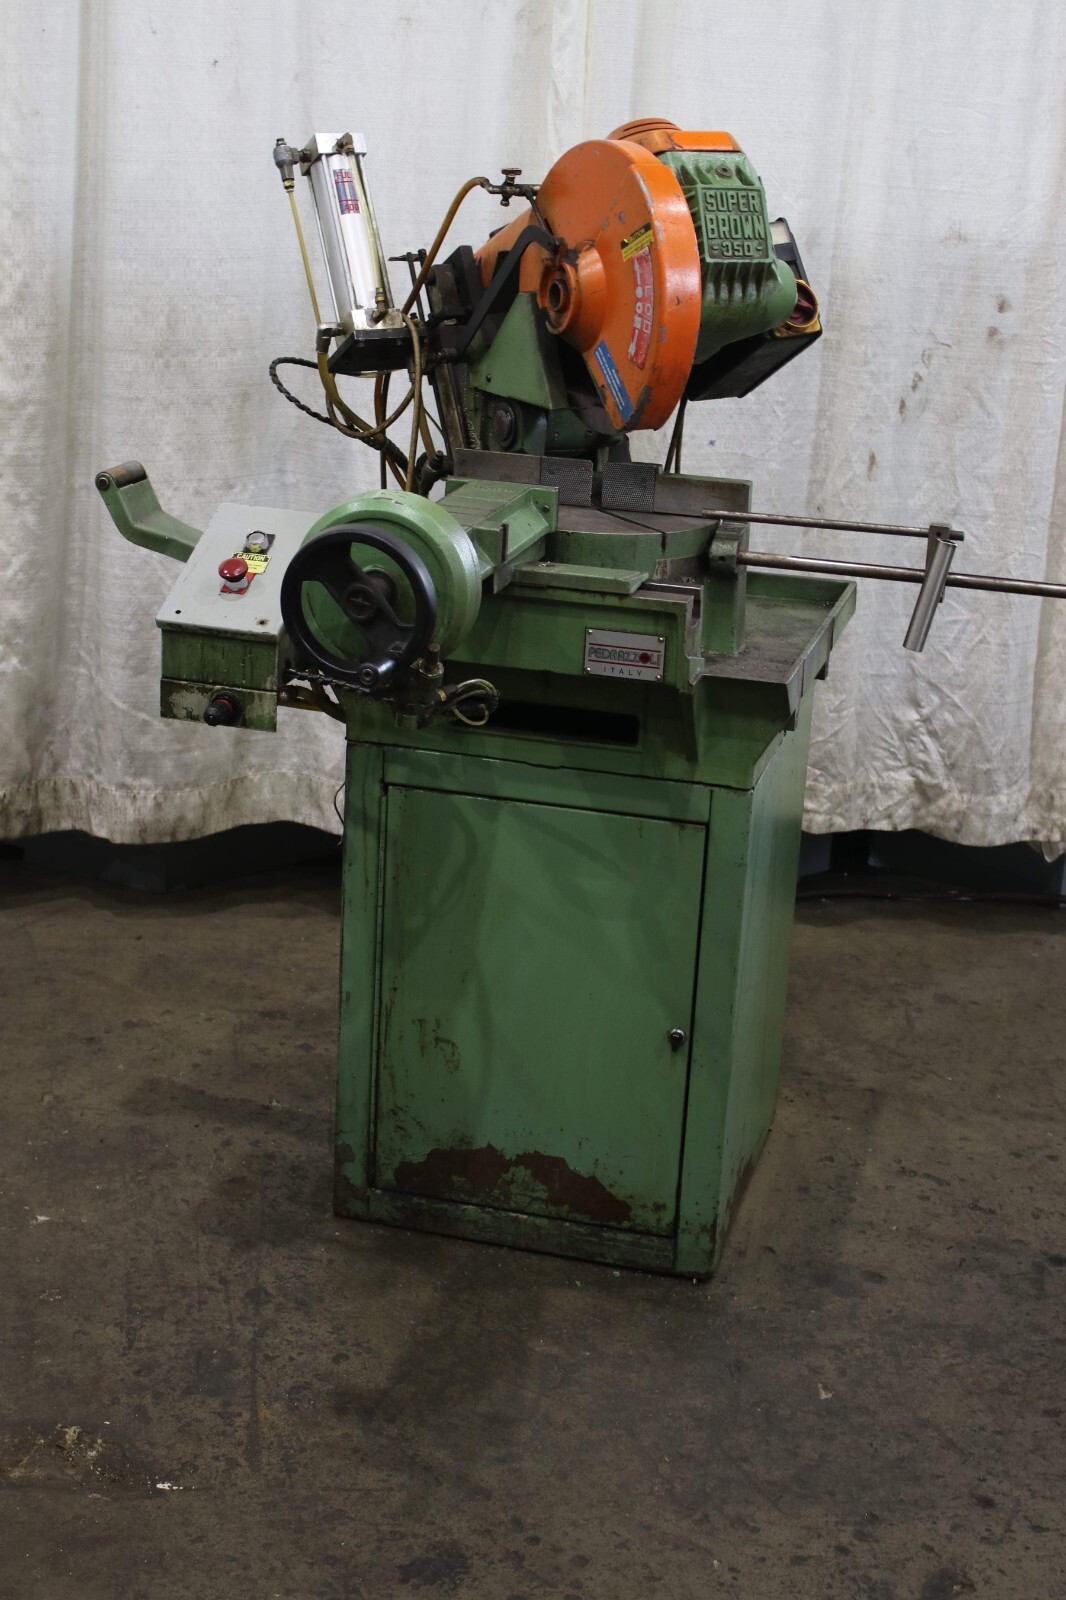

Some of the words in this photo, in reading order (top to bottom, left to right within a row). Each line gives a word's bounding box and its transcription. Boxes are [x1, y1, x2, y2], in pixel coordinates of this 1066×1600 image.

[705, 191, 760, 213] SUPER
[705, 214, 766, 239] BROWN
[236, 553, 266, 562] CAUTION
[588, 646, 662, 667] PEDRAZZOLI
[603, 666, 643, 677] ITALY
